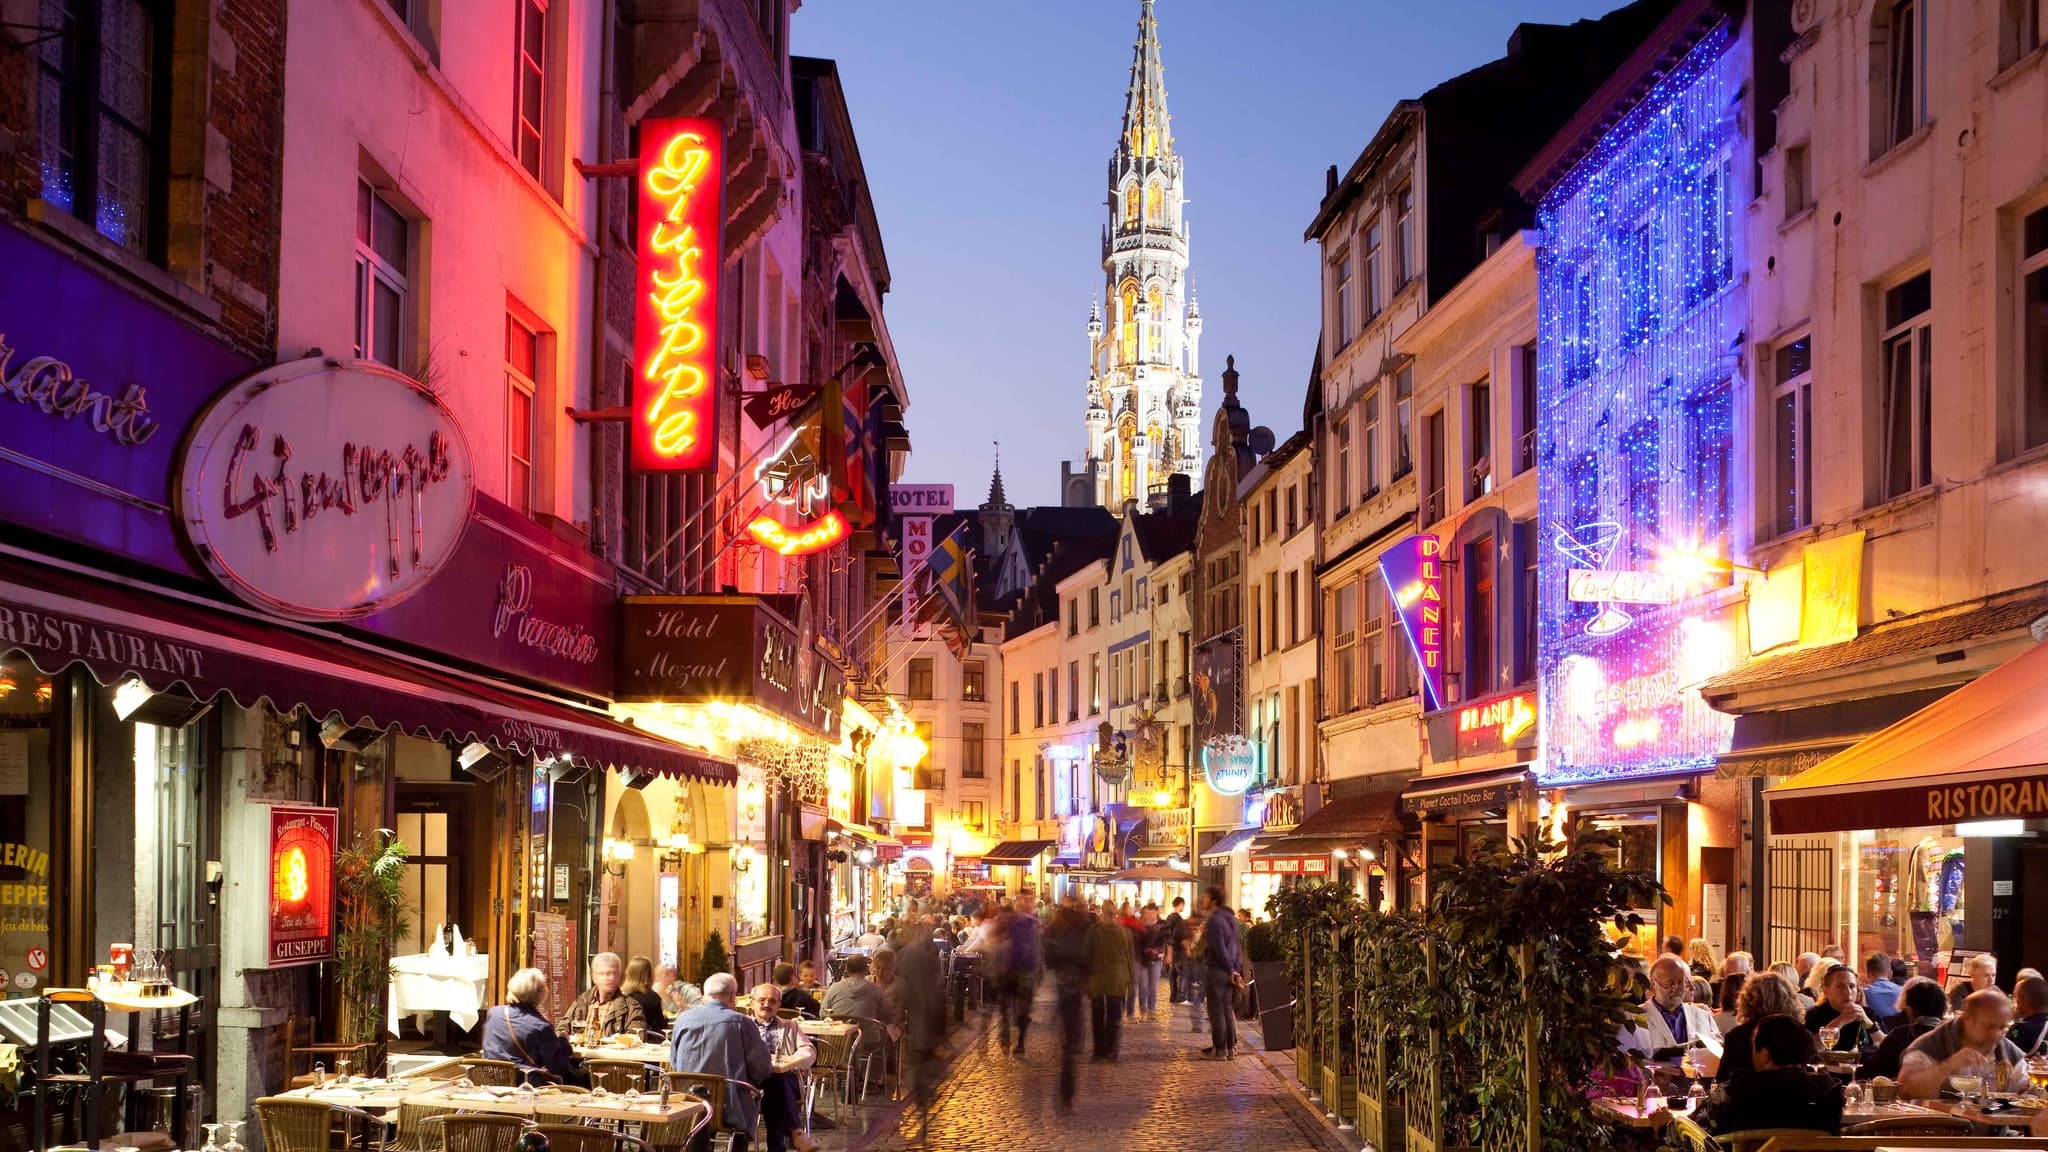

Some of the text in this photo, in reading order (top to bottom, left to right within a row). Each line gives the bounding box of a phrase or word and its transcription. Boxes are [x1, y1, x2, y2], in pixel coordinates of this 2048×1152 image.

[645, 131, 711, 456] Giuseppe
[889, 490, 950, 506] HOTEL
[748, 514, 840, 556] Mozart
[1422, 540, 1441, 668] PLANET
[646, 610, 720, 638] Hotel
[0, 606, 204, 679] RESTAURANT
[634, 651, 729, 689] Mozart
[1460, 696, 1523, 732] PLANET
[1261, 792, 1295, 826] CEBERG
[1420, 790, 1496, 809] Planet Coctail Disco Bar
[0, 842, 49, 877] ERIA
[276, 939, 327, 957] GIUSEPPE
